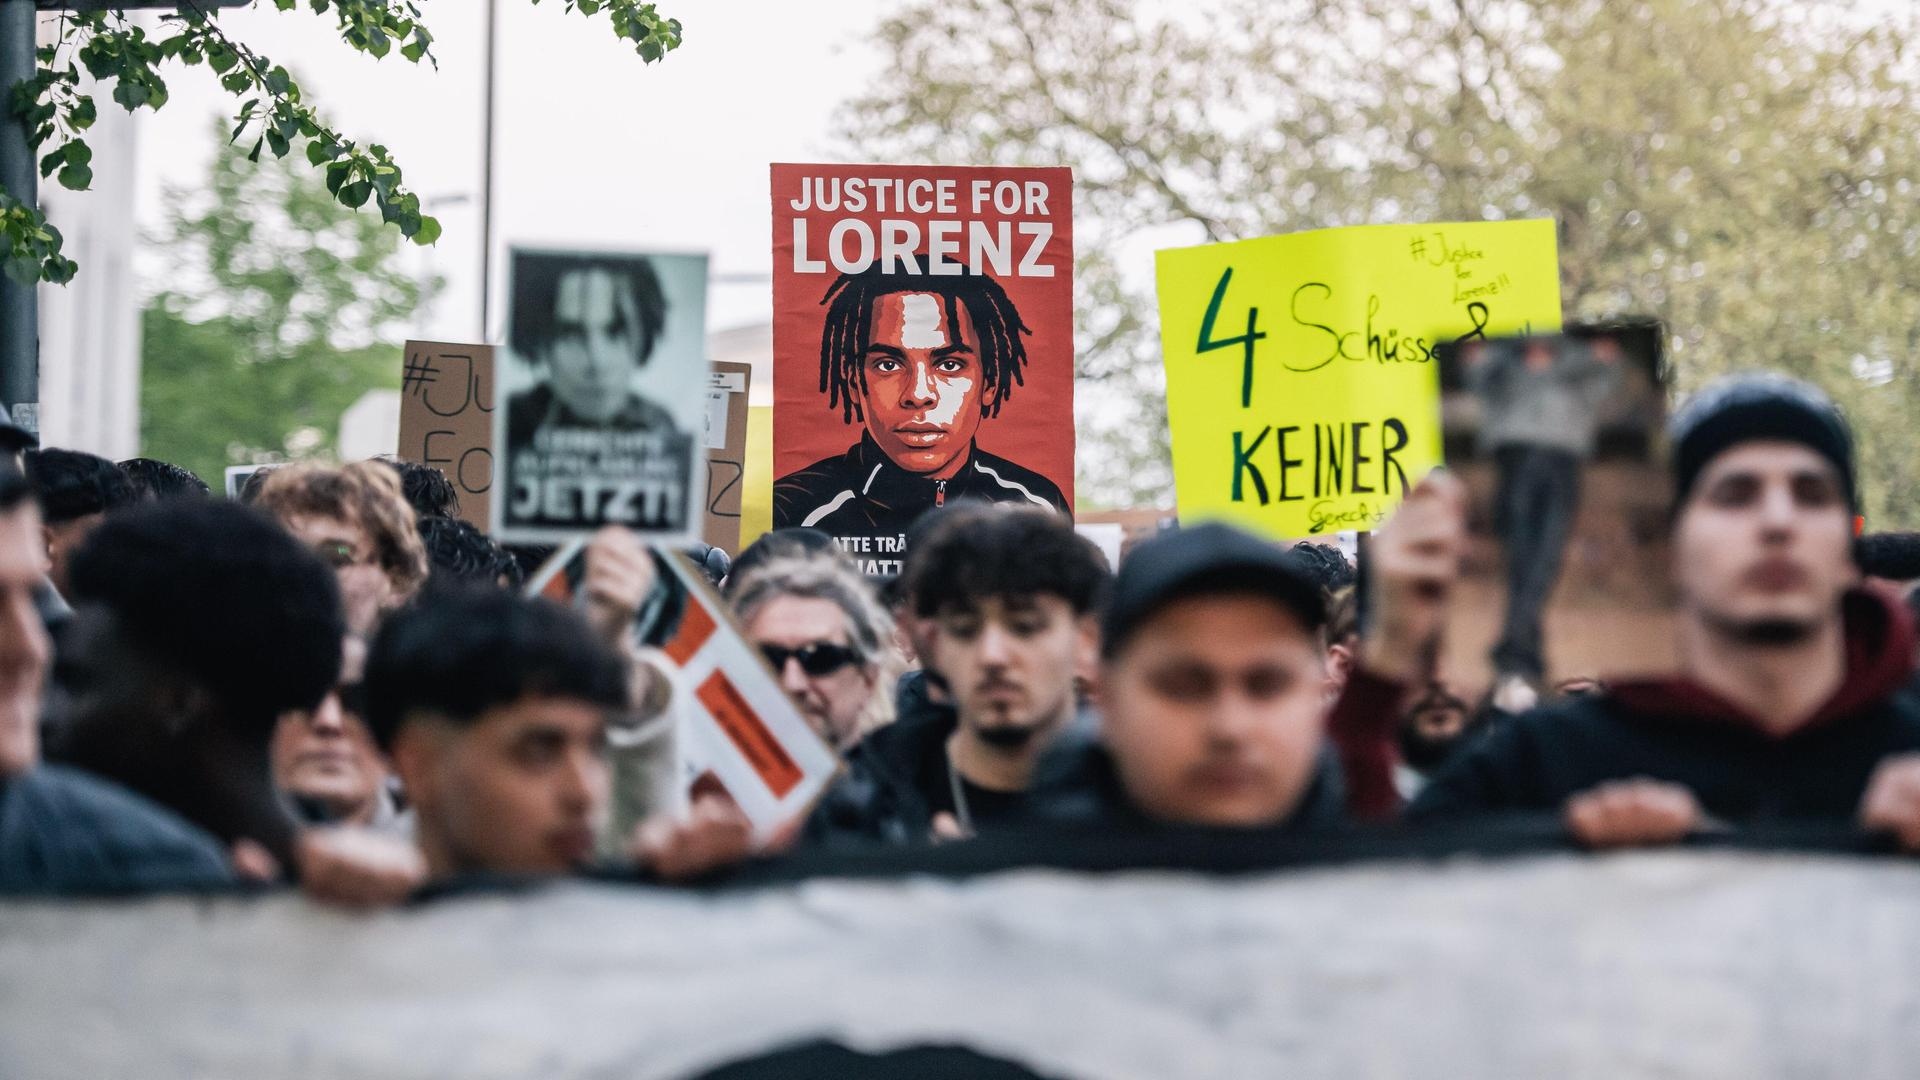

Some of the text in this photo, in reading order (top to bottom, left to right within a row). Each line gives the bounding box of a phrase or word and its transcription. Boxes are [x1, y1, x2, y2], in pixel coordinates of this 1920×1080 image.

[790, 177, 1050, 216] JUSTICE FOR
[793, 217, 1055, 278] LORENZ
[1196, 267, 1266, 408] 4
[1231, 417, 1411, 506] KEINER
